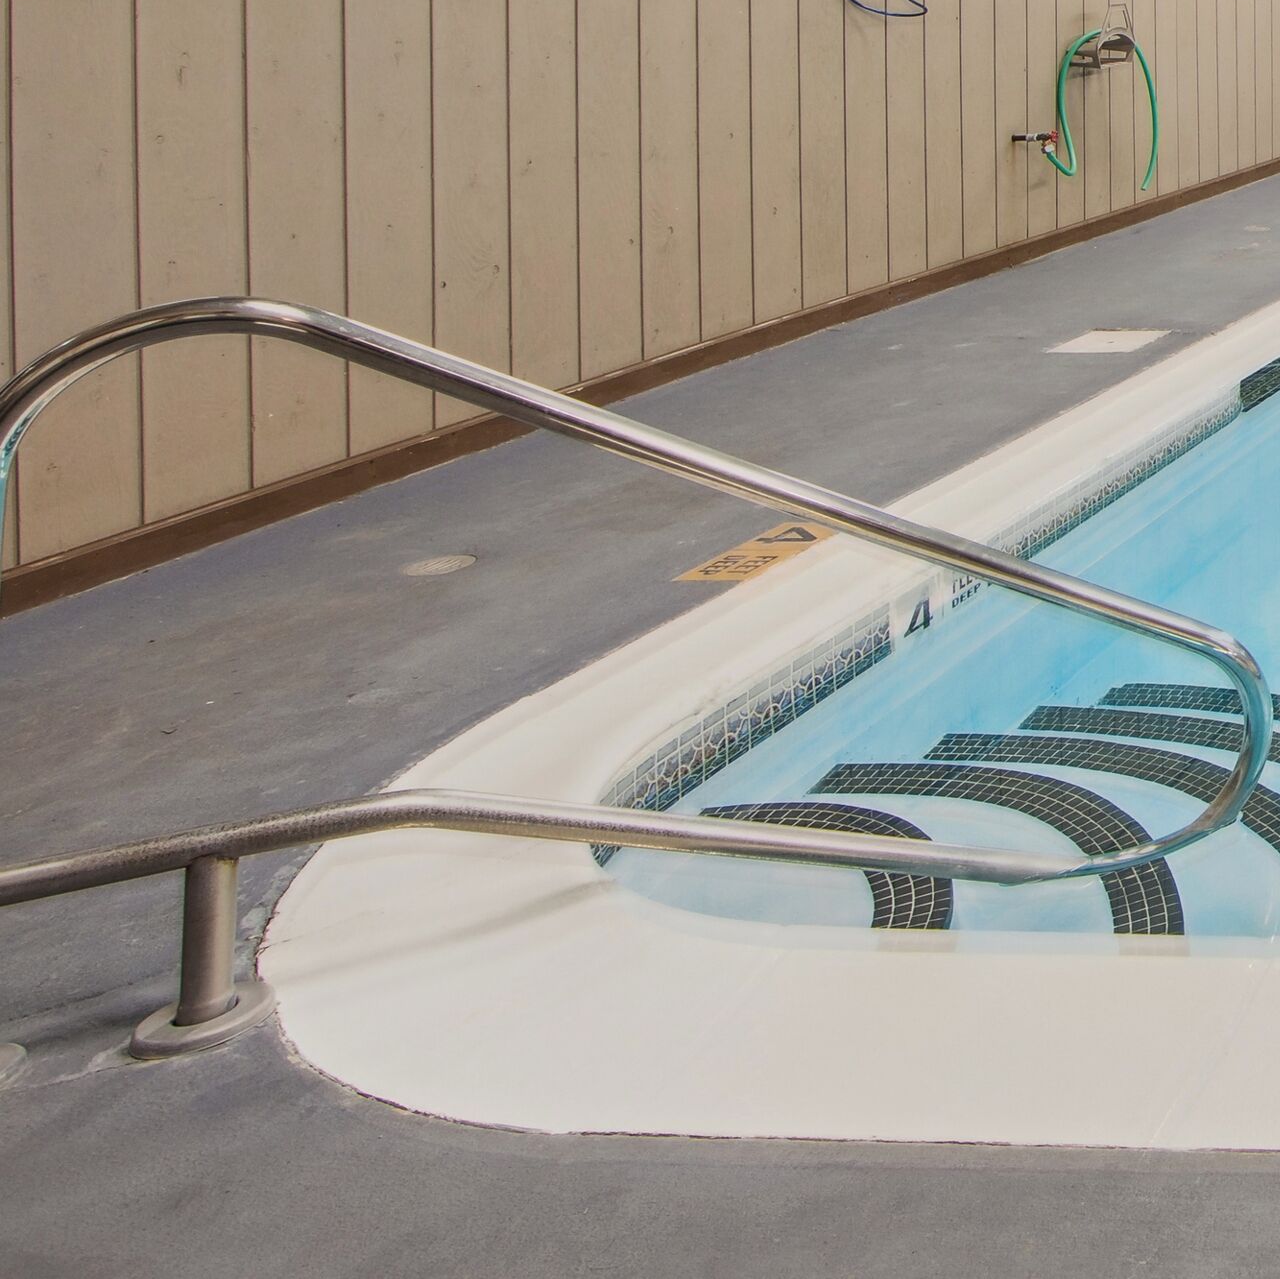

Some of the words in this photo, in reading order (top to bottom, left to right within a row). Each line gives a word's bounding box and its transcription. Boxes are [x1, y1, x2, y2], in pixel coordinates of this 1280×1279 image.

[755, 526, 817, 544] 4
[727, 555, 779, 574] FEET
[952, 583, 981, 608] DEEP
[904, 597, 933, 638] 4
